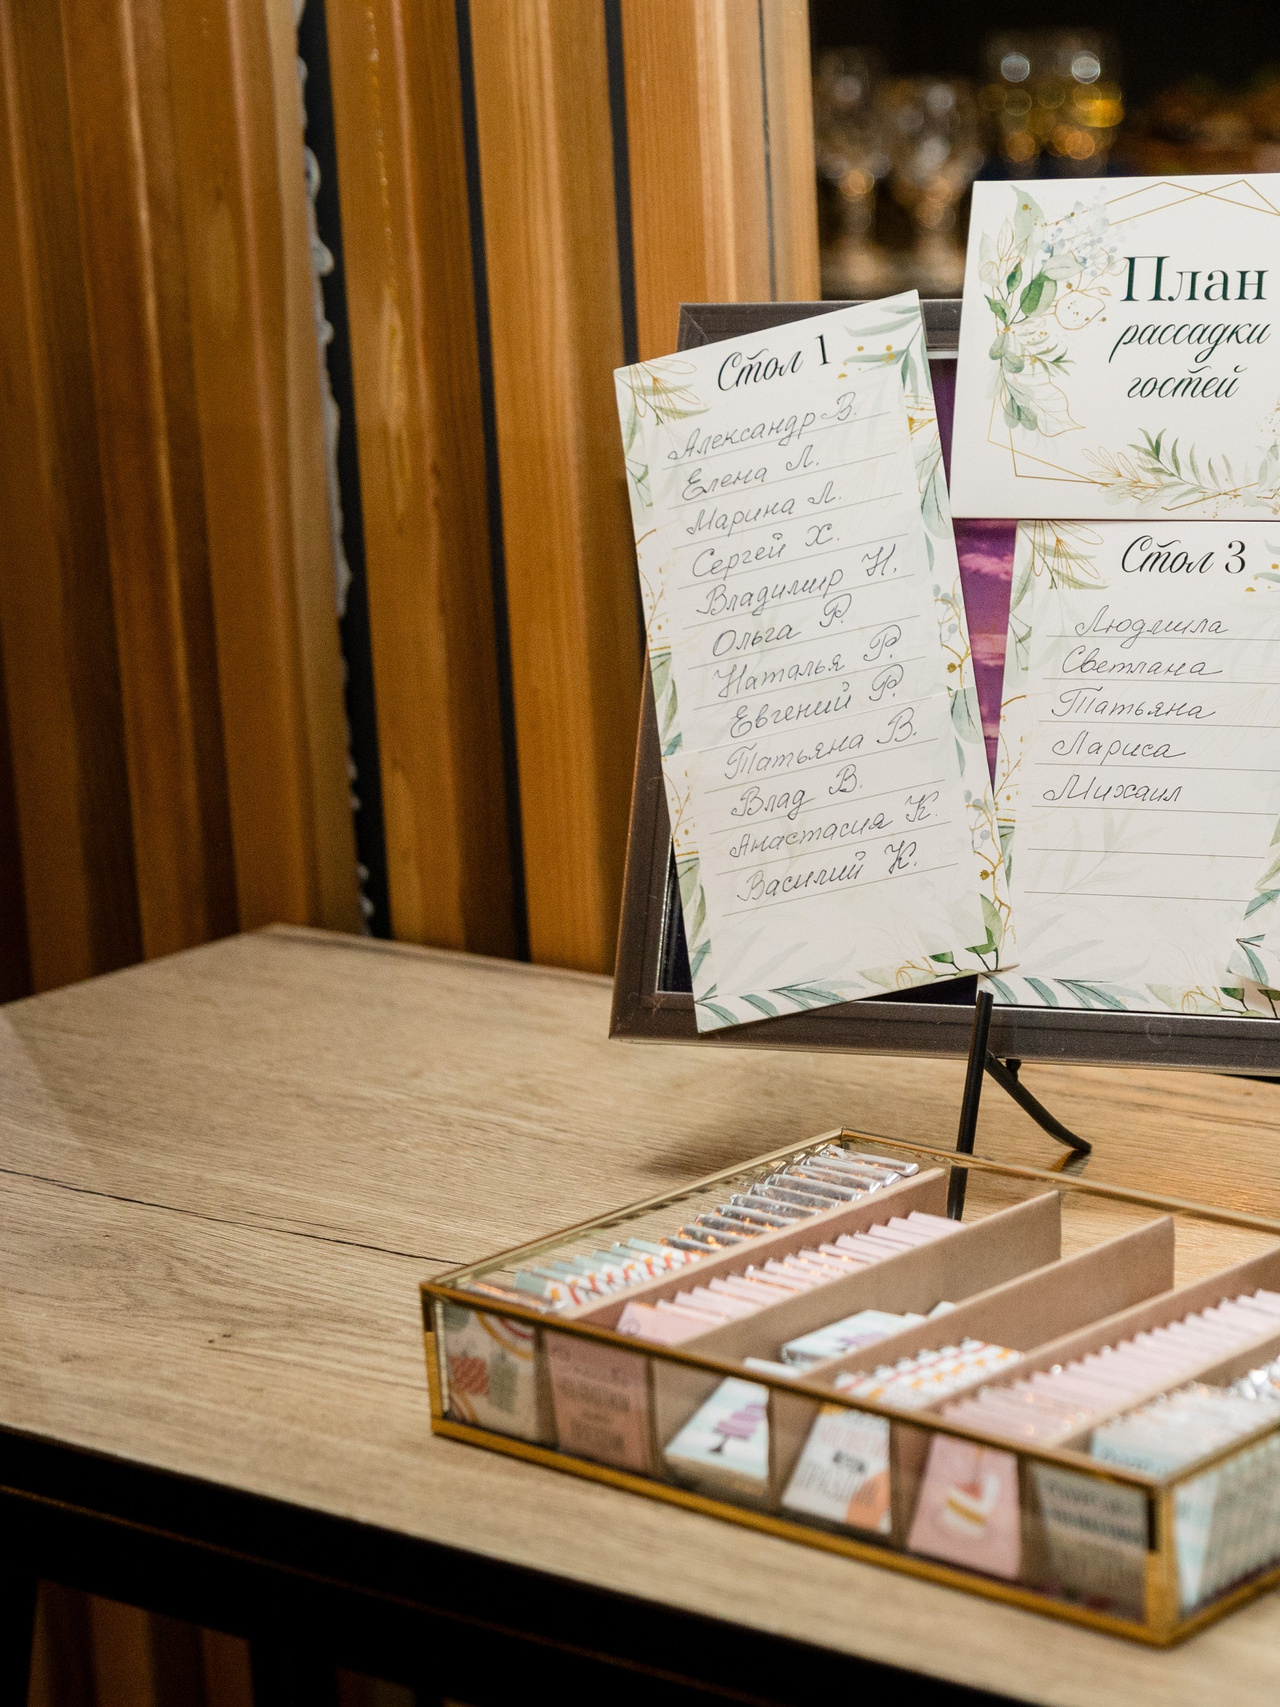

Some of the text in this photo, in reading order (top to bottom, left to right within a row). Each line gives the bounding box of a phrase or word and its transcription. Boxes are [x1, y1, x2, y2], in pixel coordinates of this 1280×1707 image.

[1119, 255, 1269, 302] План
[717, 334, 832, 391] Стол 1
[1109, 320, 1271, 363] рассадки
[1126, 365, 1248, 399] гостей
[667, 411, 817, 461] Александр
[681, 444, 819, 501] Елена Л.
[686, 480, 842, 538] Марина Л.
[693, 523, 840, 580] Сергей Х.
[1121, 535, 1246, 574] Стол 3
[696, 544, 898, 617] Владимир Н.
[712, 623, 802, 657] Ольга
[1075, 604, 1229, 649] Людмила
[714, 653, 845, 698] Наталья
[1062, 645, 1223, 675] Светлана
[730, 681, 851, 739] Евгений
[1051, 686, 1216, 720] Татьяна
[724, 707, 918, 780] Татьяна В.
[1052, 730, 1187, 766] Лариса
[730, 763, 863, 821] Влад В.
[1042, 774, 1184, 802] Михаил
[729, 816, 893, 858] Анастасия
[736, 851, 866, 902] Василий
